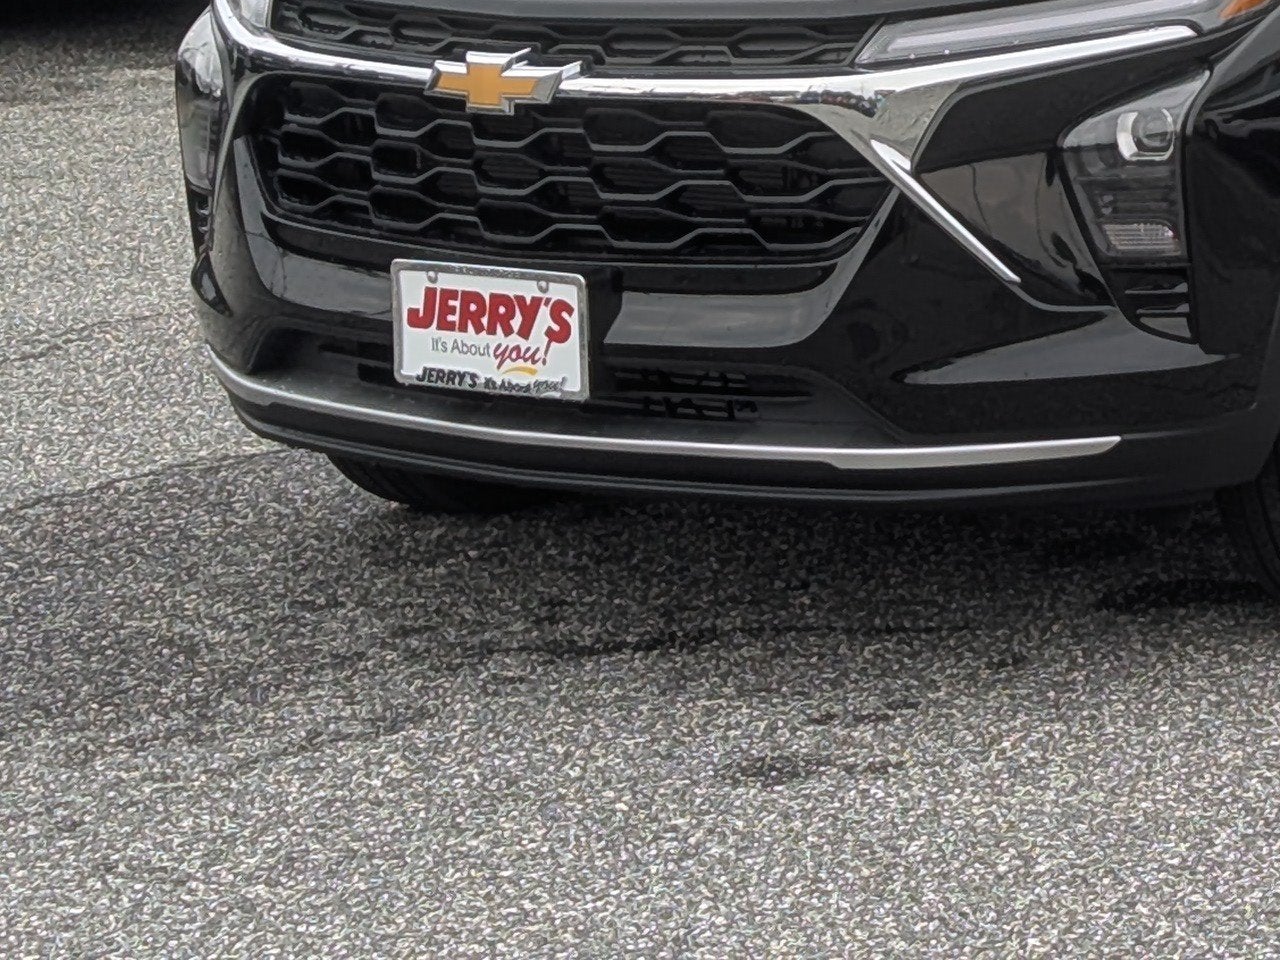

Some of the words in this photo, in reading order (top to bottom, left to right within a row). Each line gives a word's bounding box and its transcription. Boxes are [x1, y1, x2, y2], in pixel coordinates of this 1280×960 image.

[407, 286, 575, 345] JERRY'S
[432, 337, 448, 353] It's
[450, 339, 491, 357] About
[493, 340, 552, 371] you!
[415, 366, 480, 389] JERRY'S
